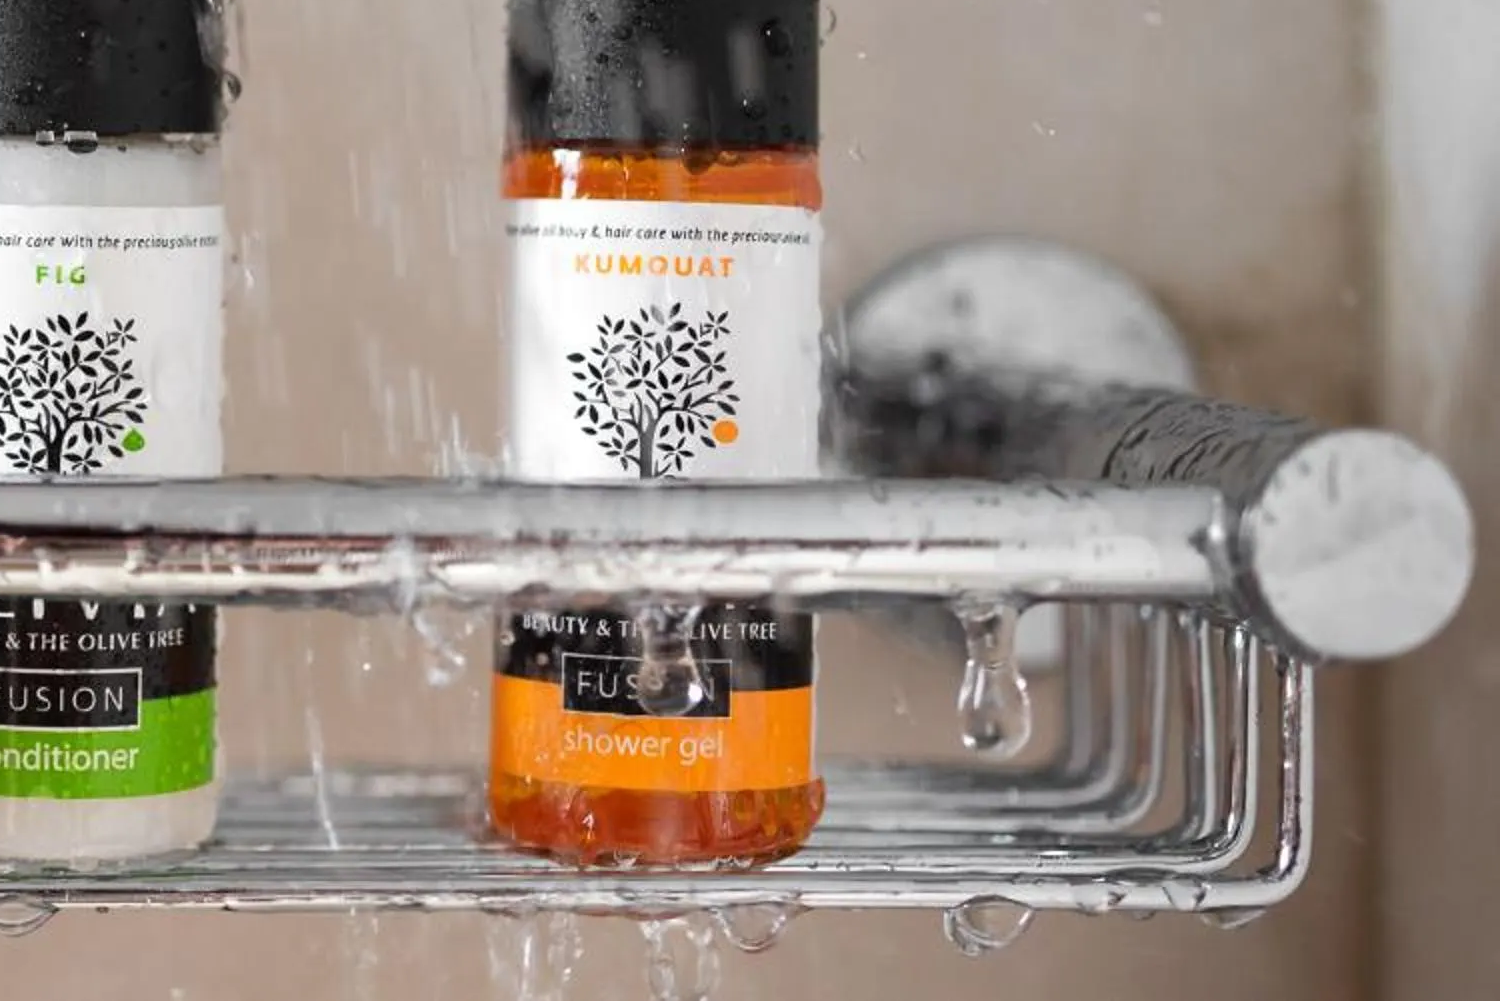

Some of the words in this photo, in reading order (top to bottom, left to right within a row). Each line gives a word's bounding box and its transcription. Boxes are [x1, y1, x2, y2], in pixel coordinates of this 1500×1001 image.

[26, 235, 55, 247] care
[60, 234, 93, 248] with
[97, 234, 120, 248] the
[123, 235, 174, 251] precious
[605, 225, 633, 239] hair
[636, 228, 667, 240] care
[671, 227, 703, 240] with
[708, 228, 729, 242] the
[36, 264, 86, 285] FIG
[5, 631, 21, 650] &
[27, 632, 69, 651] THE
[78, 632, 141, 651] OLIVE
[147, 628, 185, 649] TREE
[596, 619, 611, 637] &
[676, 622, 732, 640] LIVE
[738, 622, 777, 640] TREE
[577, 670, 715, 703] FUSN
[563, 727, 672, 758] shower
[679, 731, 724, 766] gel
